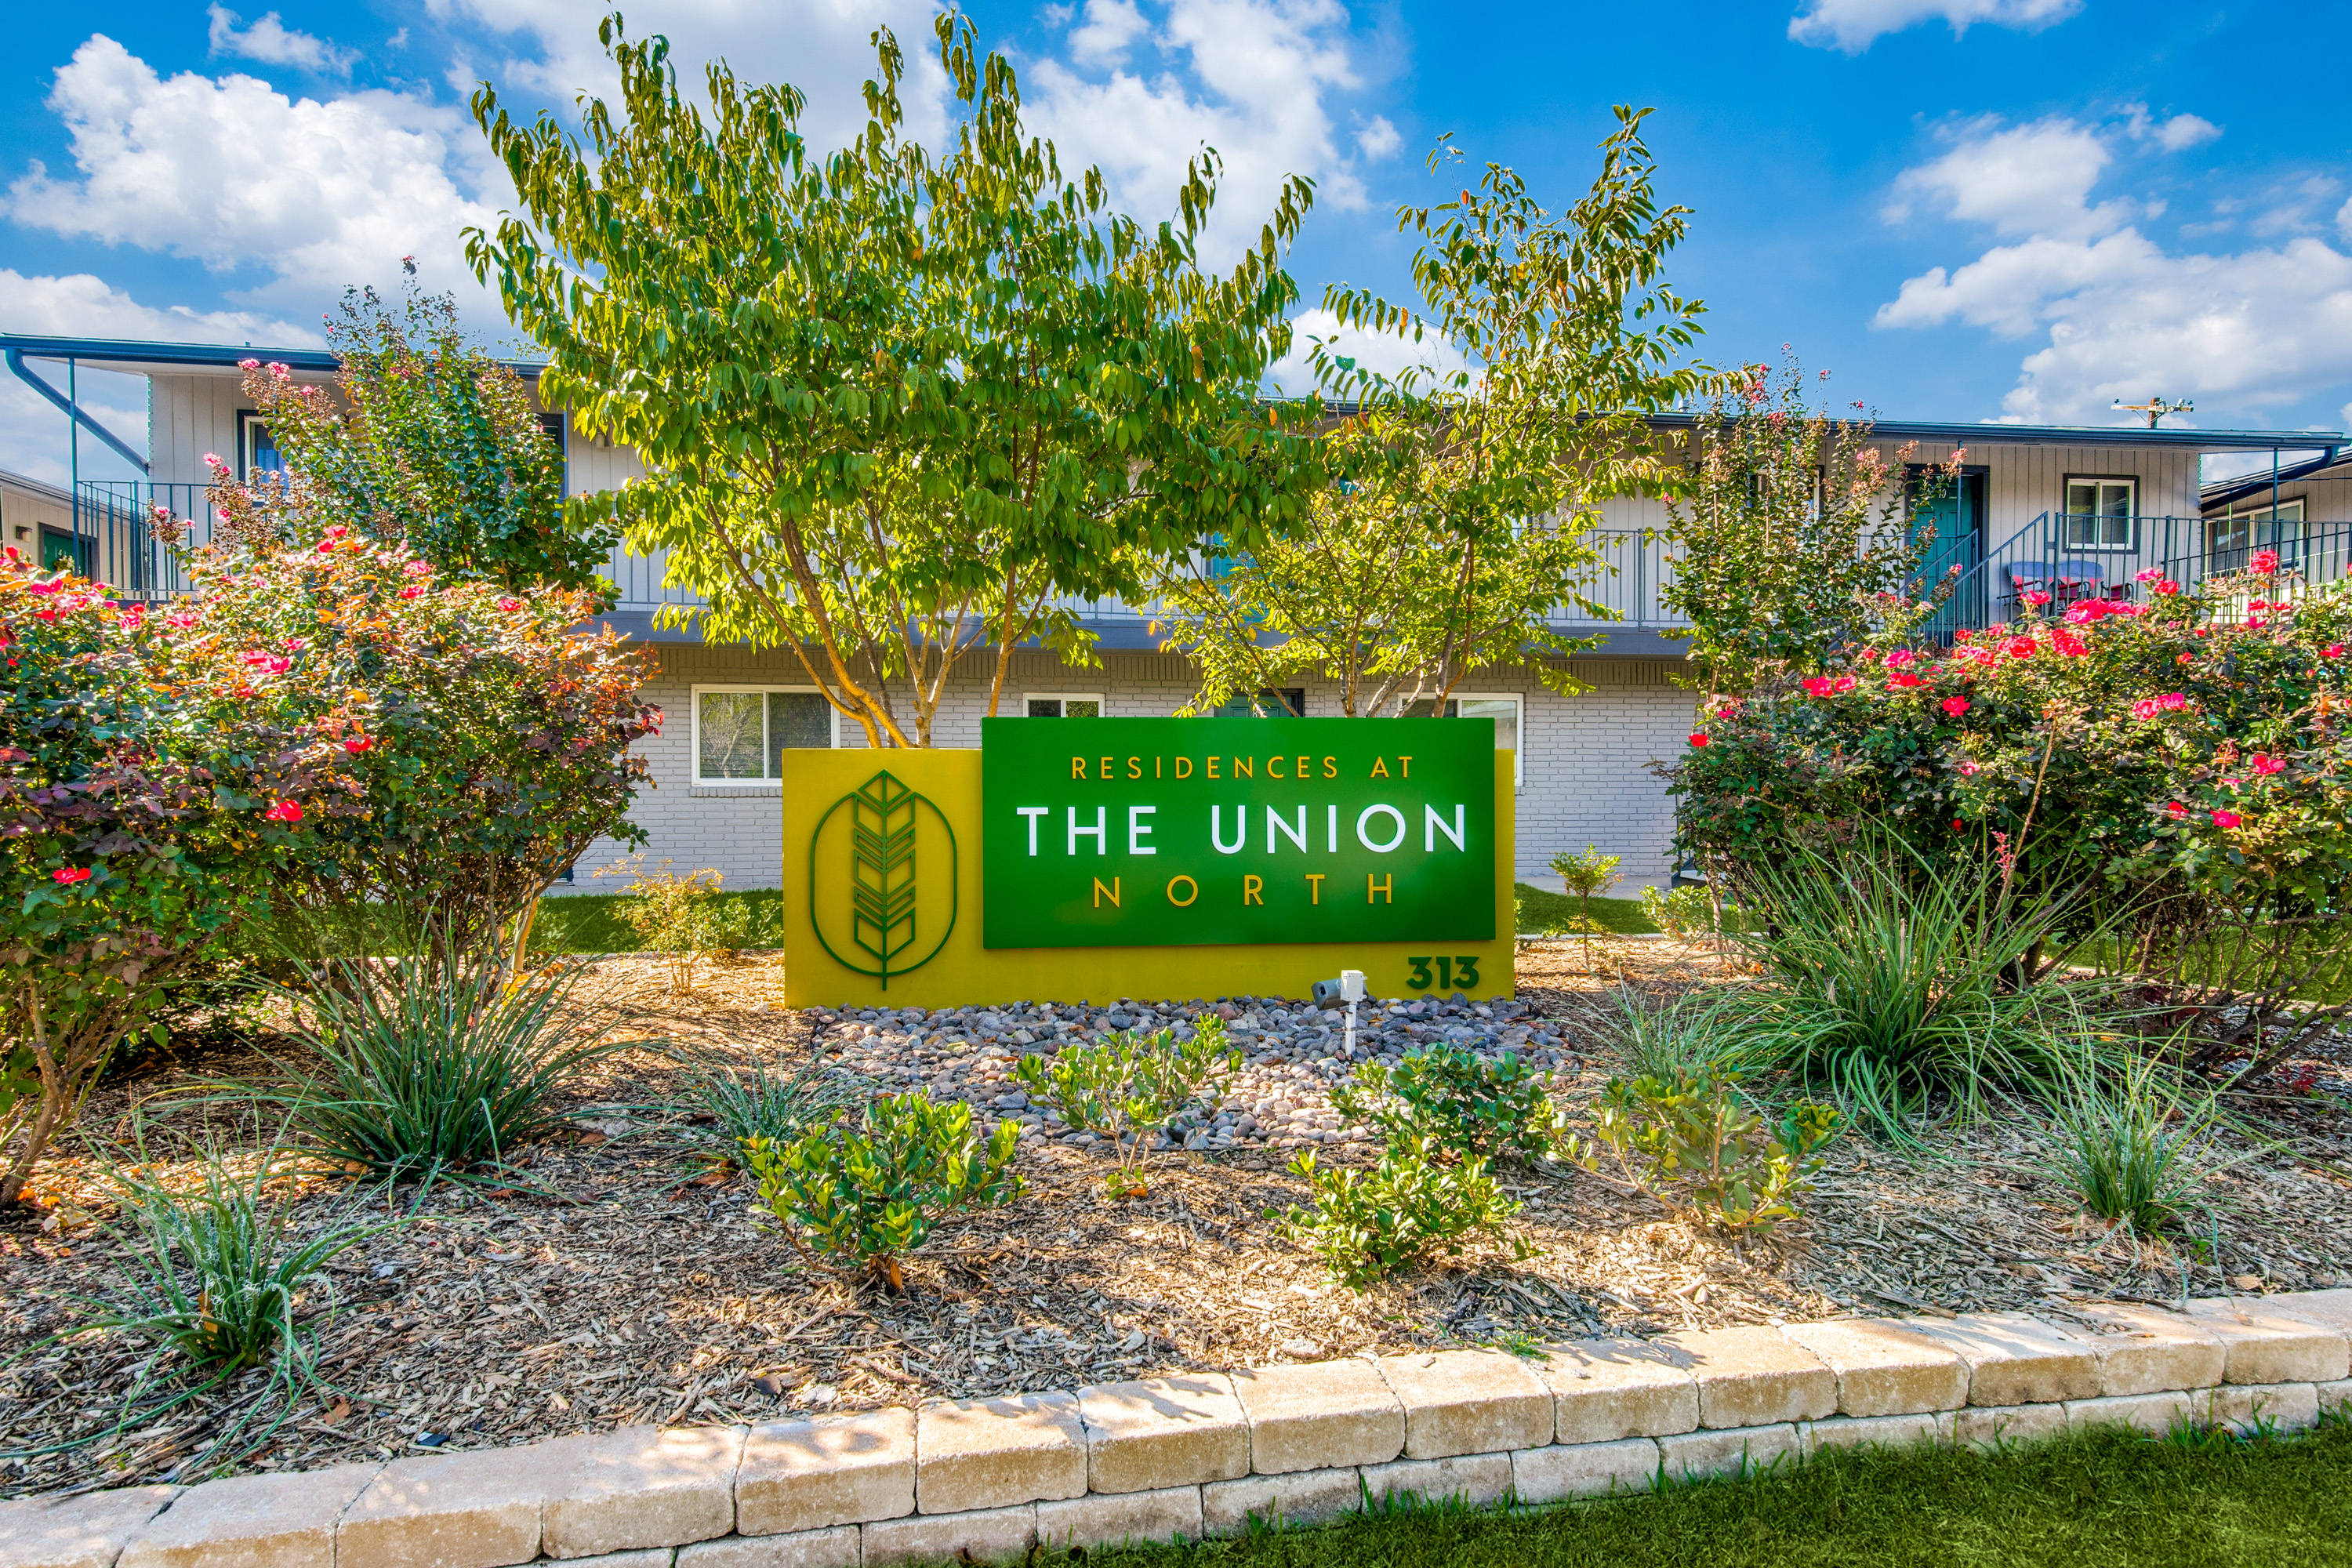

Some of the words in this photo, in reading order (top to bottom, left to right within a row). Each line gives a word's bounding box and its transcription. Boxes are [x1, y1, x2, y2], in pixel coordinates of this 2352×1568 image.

[1345, 481, 1352, 495] 7
[1072, 757, 1338, 779] RESIDENCES
[1370, 757, 1413, 779] AT
[1017, 806, 1156, 855] THE
[1211, 804, 1465, 854] UNION
[1094, 873, 1392, 908] NORTH
[1406, 956, 1480, 990] 313
